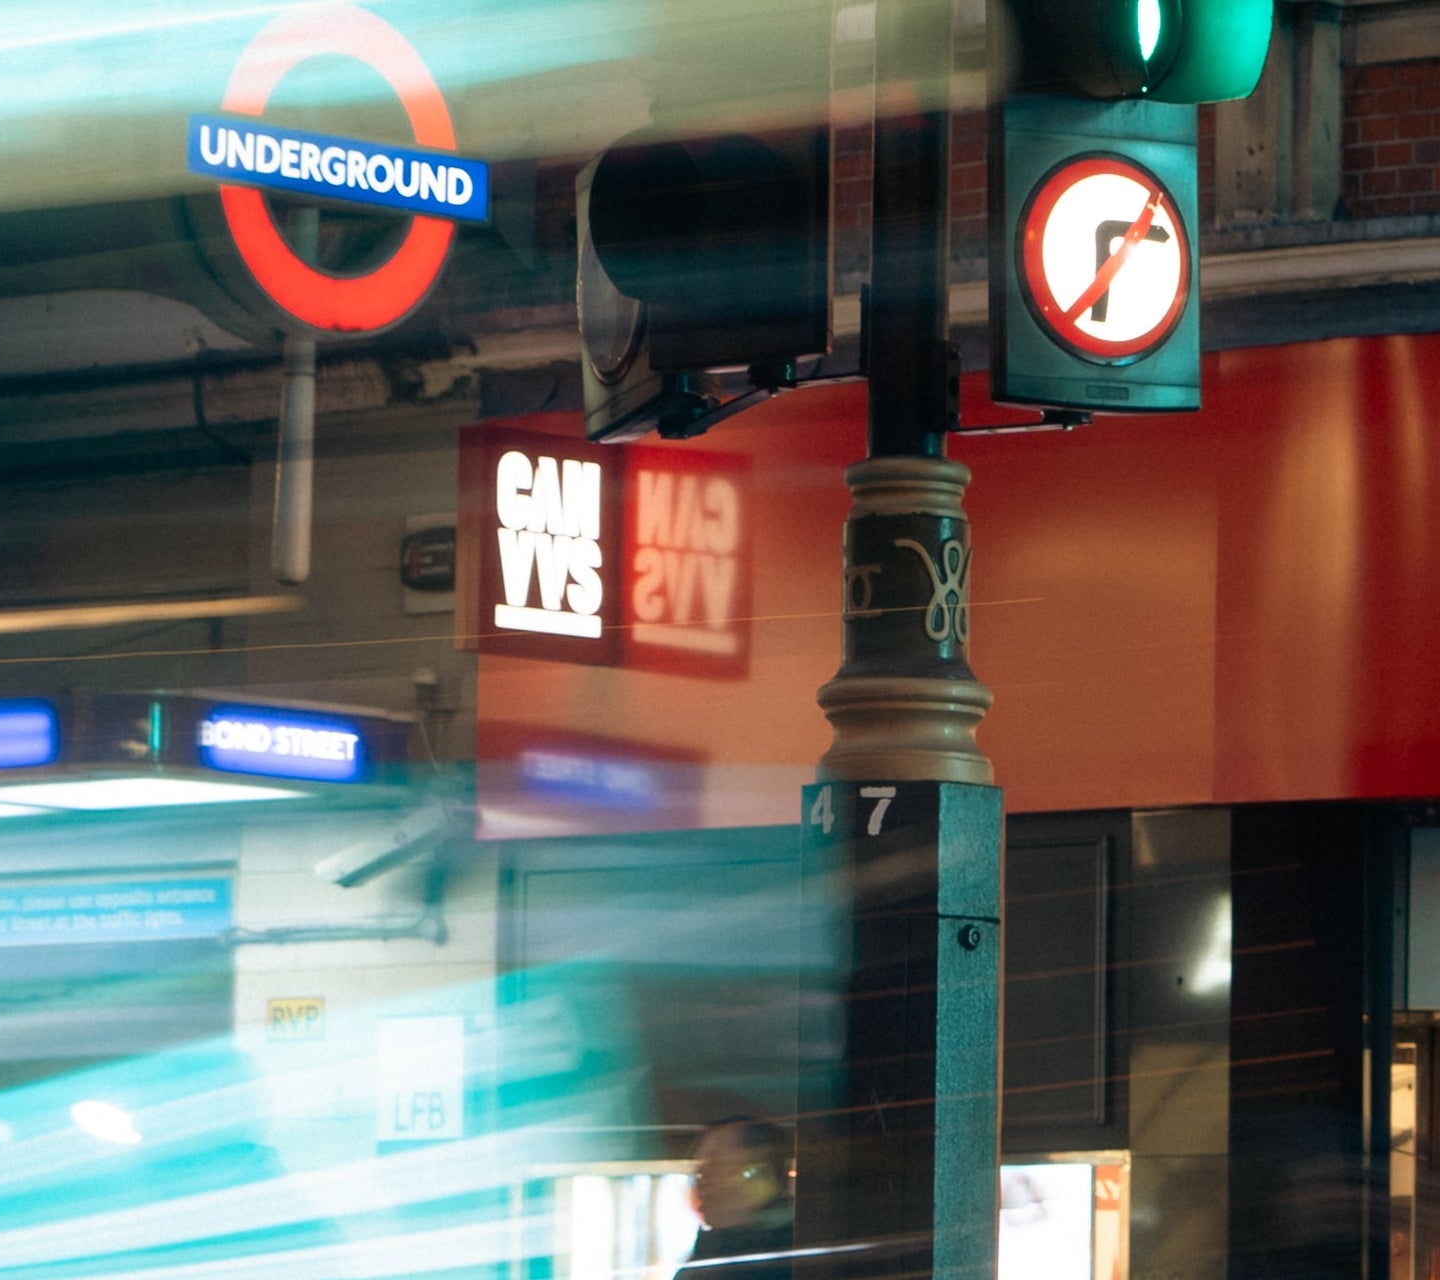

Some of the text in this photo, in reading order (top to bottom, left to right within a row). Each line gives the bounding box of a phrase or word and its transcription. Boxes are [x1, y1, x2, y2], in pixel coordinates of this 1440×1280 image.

[200, 124, 474, 206] UNDERGROUND
[496, 450, 601, 540] CAN
[200, 719, 359, 761] BOND STREET
[272, 1004, 320, 1032] RVP
[394, 1090, 446, 1132] LFB
